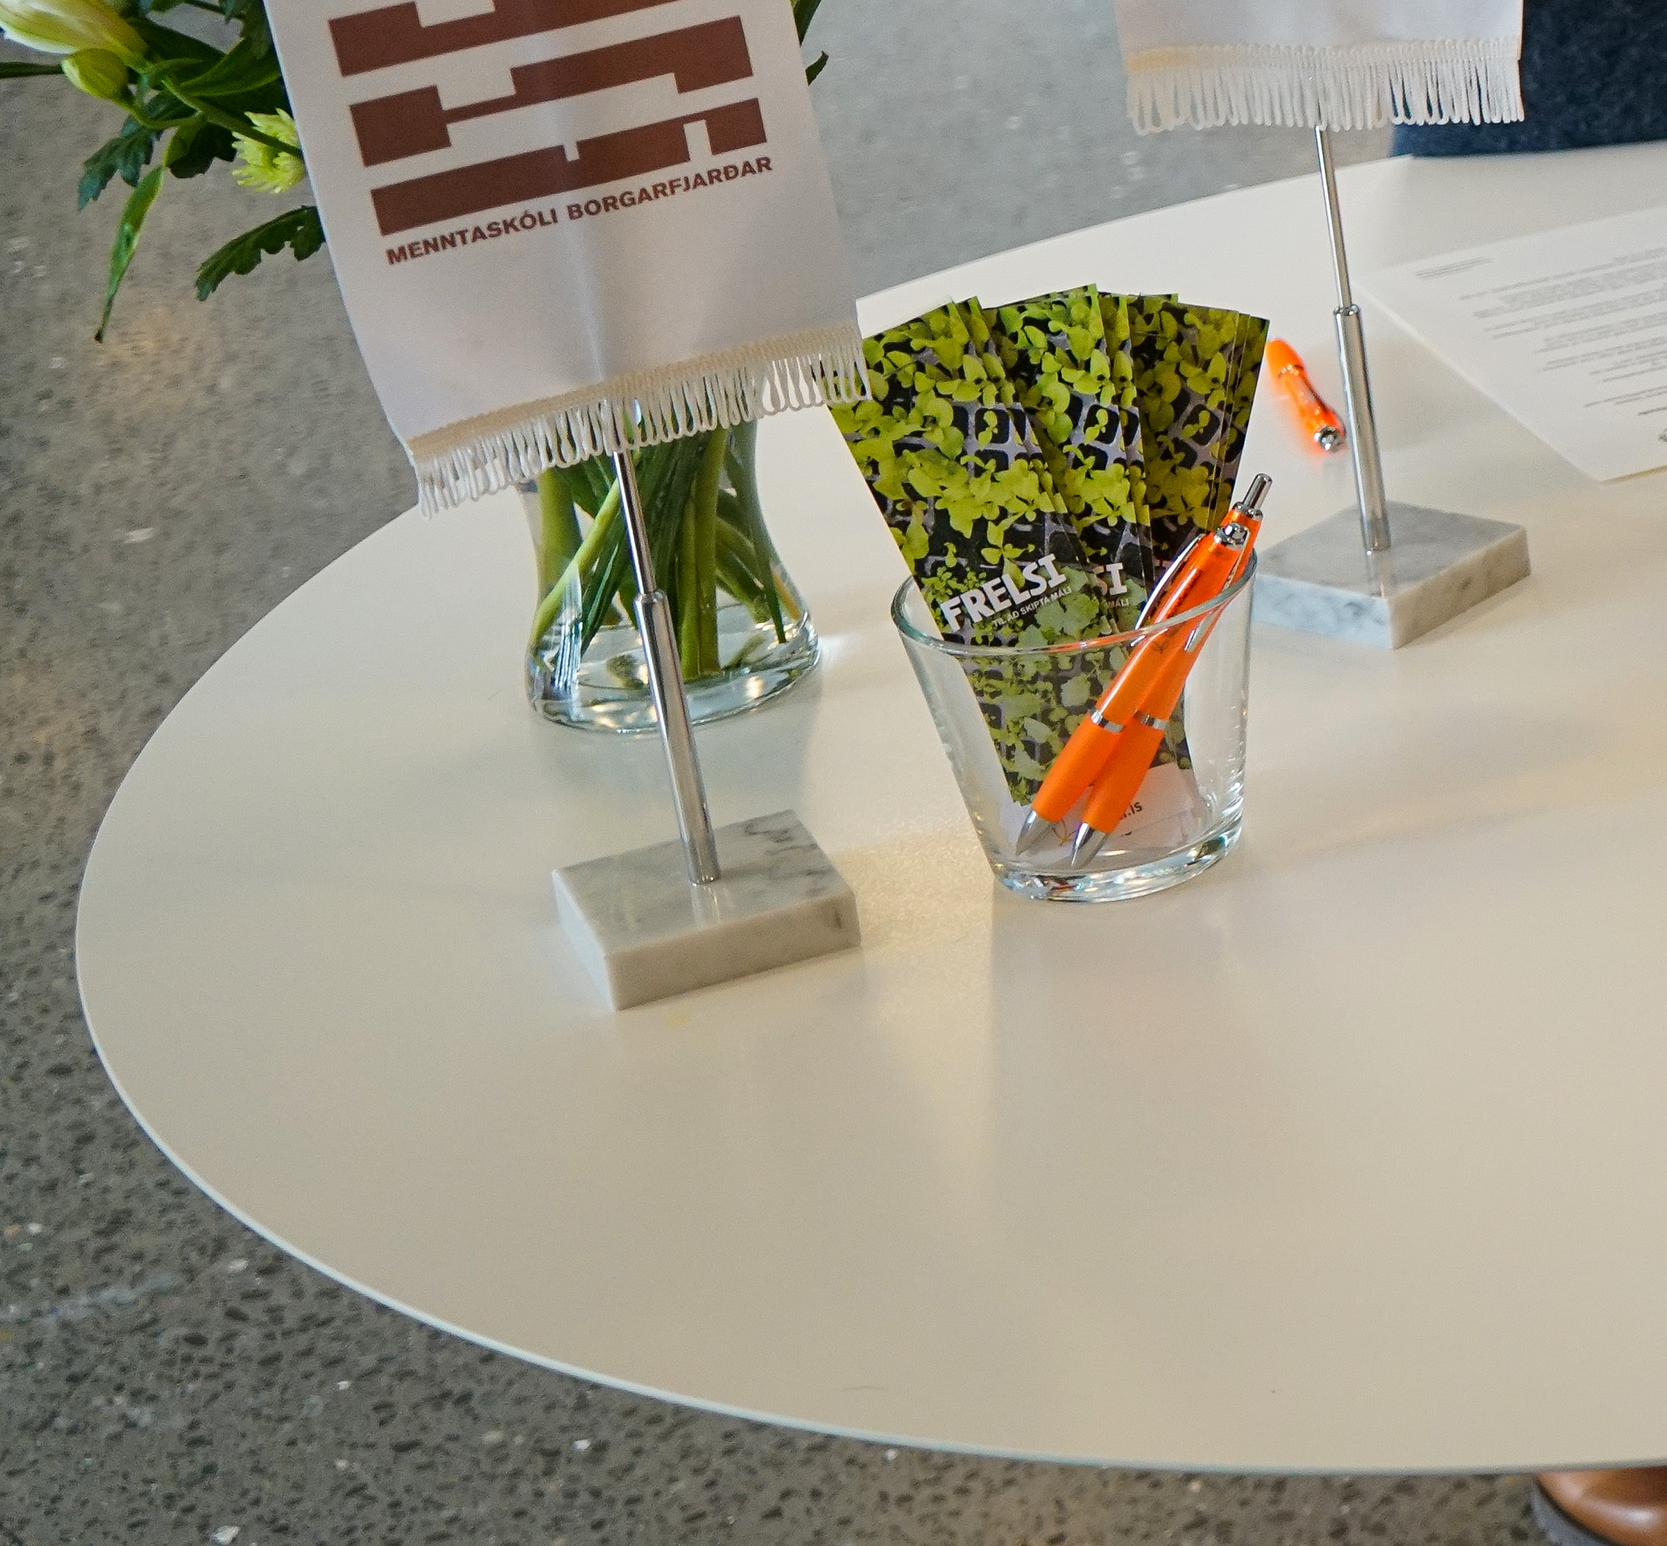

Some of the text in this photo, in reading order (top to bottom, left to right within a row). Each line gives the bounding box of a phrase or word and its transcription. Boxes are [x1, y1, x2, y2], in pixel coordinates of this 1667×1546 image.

[384, 155, 774, 266] MENNTASKÓLI BORGARFJARÐAR
[939, 553, 1068, 632] FRELSI
